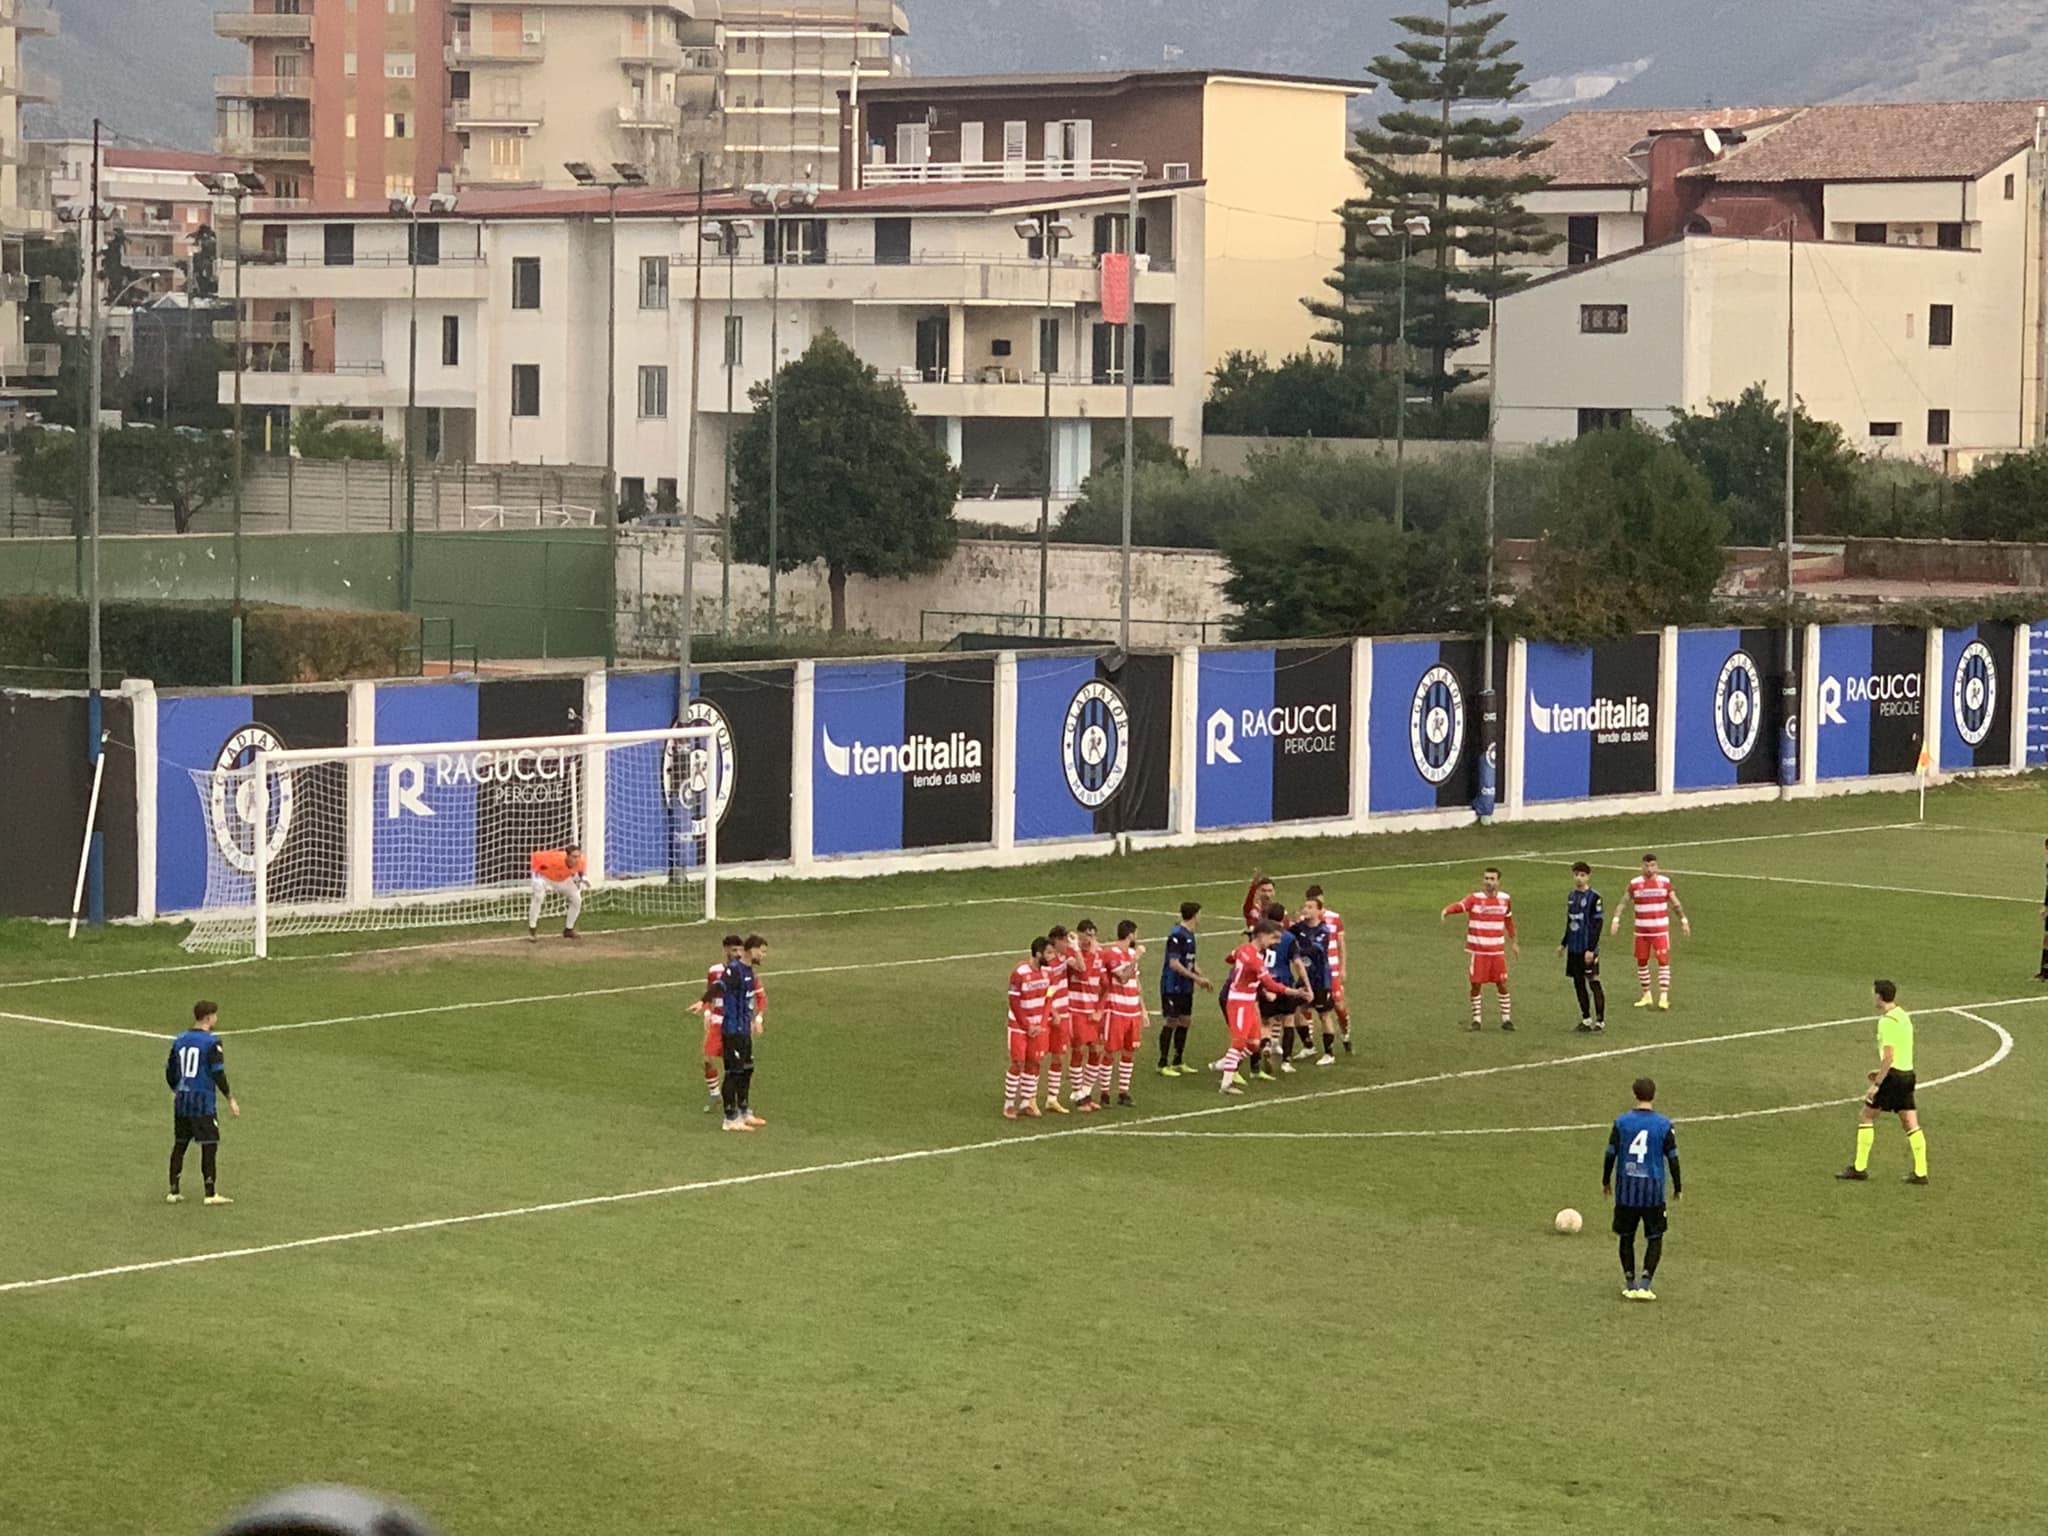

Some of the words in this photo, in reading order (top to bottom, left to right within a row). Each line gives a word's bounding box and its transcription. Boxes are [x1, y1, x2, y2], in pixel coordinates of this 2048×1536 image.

[1846, 672, 1920, 701] RAGUCCI
[1066, 684, 1128, 732] GLADIATOR
[1242, 703, 1337, 738] RAGUCCI
[1552, 696, 1649, 734] tenditalia
[1880, 700, 1920, 717] PERGOLE
[852, 731, 982, 776] tenditalia
[1284, 735, 1337, 755] PERGOLE
[436, 747, 565, 788] RAGUCCI
[913, 772, 942, 788] tende
[944, 770, 958, 786] da
[959, 769, 982, 784] sole
[494, 783, 565, 805] PERGOLE
[178, 1045, 200, 1079] 10
[1628, 1129, 1649, 1164] 4
